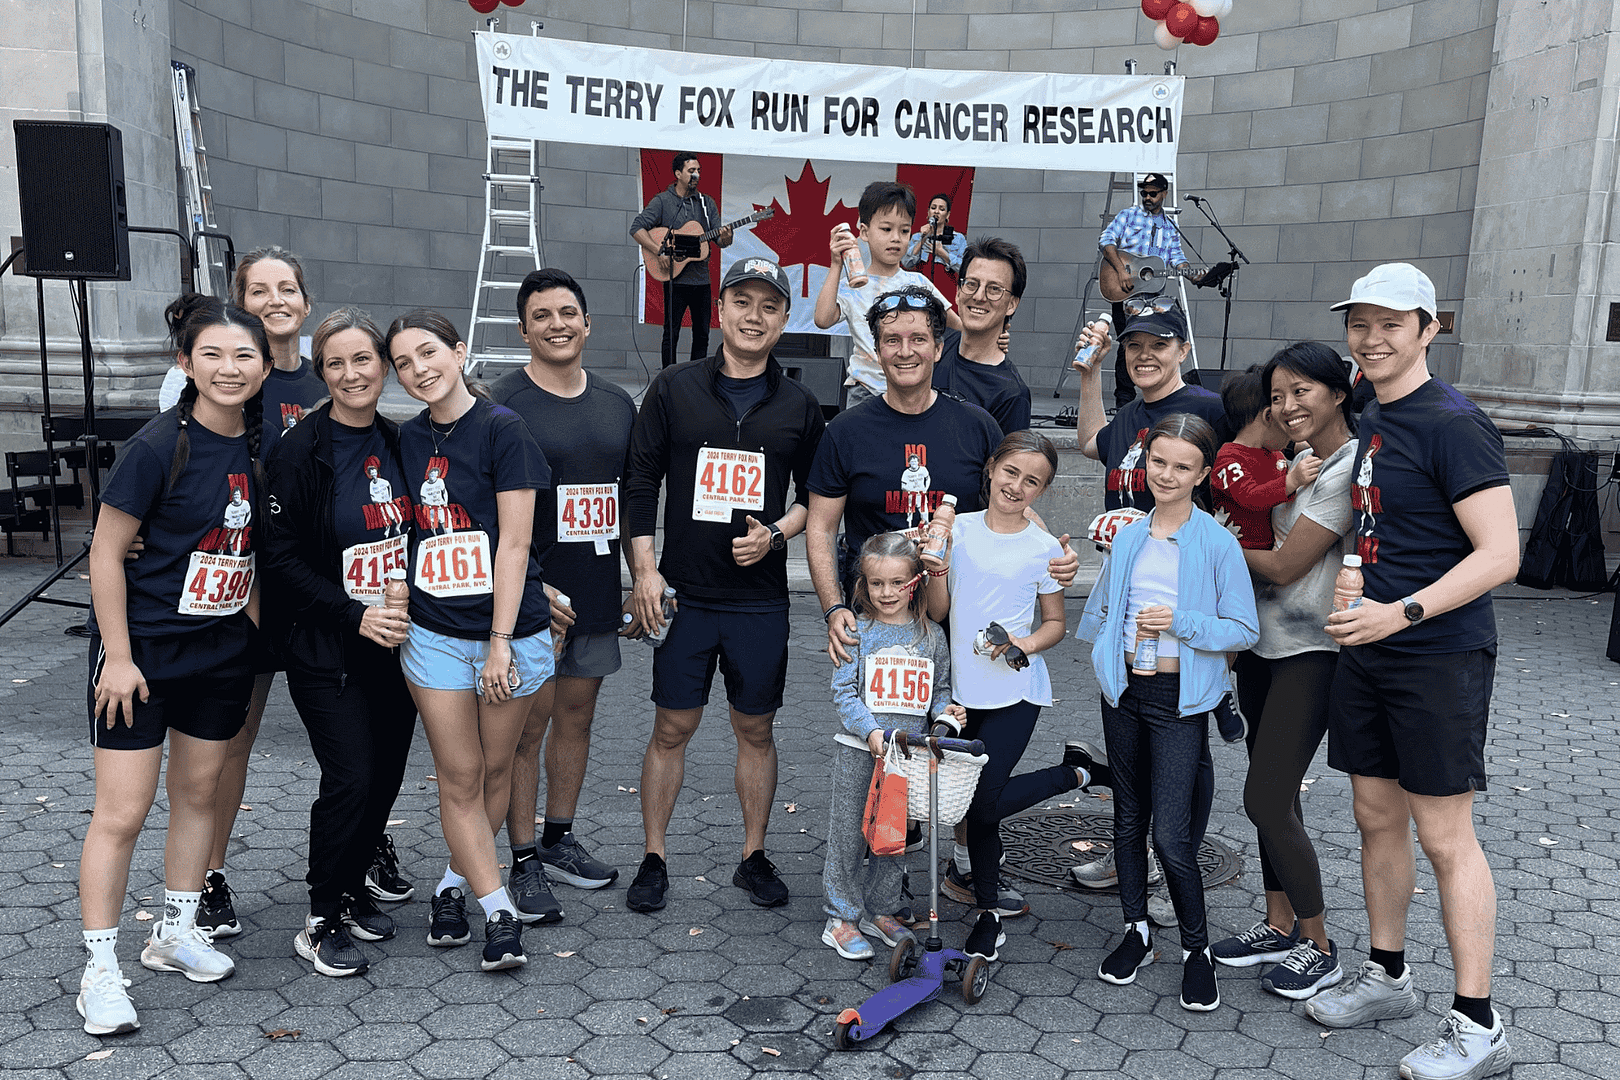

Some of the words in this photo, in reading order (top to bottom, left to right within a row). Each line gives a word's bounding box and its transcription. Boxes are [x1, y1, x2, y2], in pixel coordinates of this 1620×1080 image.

[492, 65, 549, 110] THE
[565, 75, 664, 122] TERRY
[678, 86, 736, 129] FOX
[751, 90, 809, 133] RUN
[823, 96, 880, 137] FOR
[895, 98, 1008, 142] CANCER
[1022, 104, 1174, 144] RESEARCH
[706, 451, 720, 460] 2024
[720, 451, 738, 461] TERRY
[738, 454, 747, 462] FOX
[747, 455, 758, 463] RUN
[904, 443, 927, 468] NO
[700, 462, 762, 497] 4162
[565, 487, 579, 496] 2024
[580, 487, 595, 496] TERRY
[595, 486, 604, 495] FOX
[702, 494, 728, 502] CENTRAL
[562, 496, 616, 529] 4330
[437, 536, 453, 546] TERRY
[454, 535, 467, 544] FOX
[468, 534, 481, 543] RUN
[354, 547, 369, 556] 2024
[200, 555, 216, 566] 2024
[218, 557, 238, 568] TERRY
[347, 548, 406, 587] 4155
[421, 546, 487, 584] 4161
[188, 567, 254, 603] 4398
[189, 602, 218, 610] CENTRAL
[875, 657, 889, 666] 2024
[890, 657, 906, 666] TERRY
[908, 659, 918, 667] FOX
[869, 668, 931, 703] 4156
